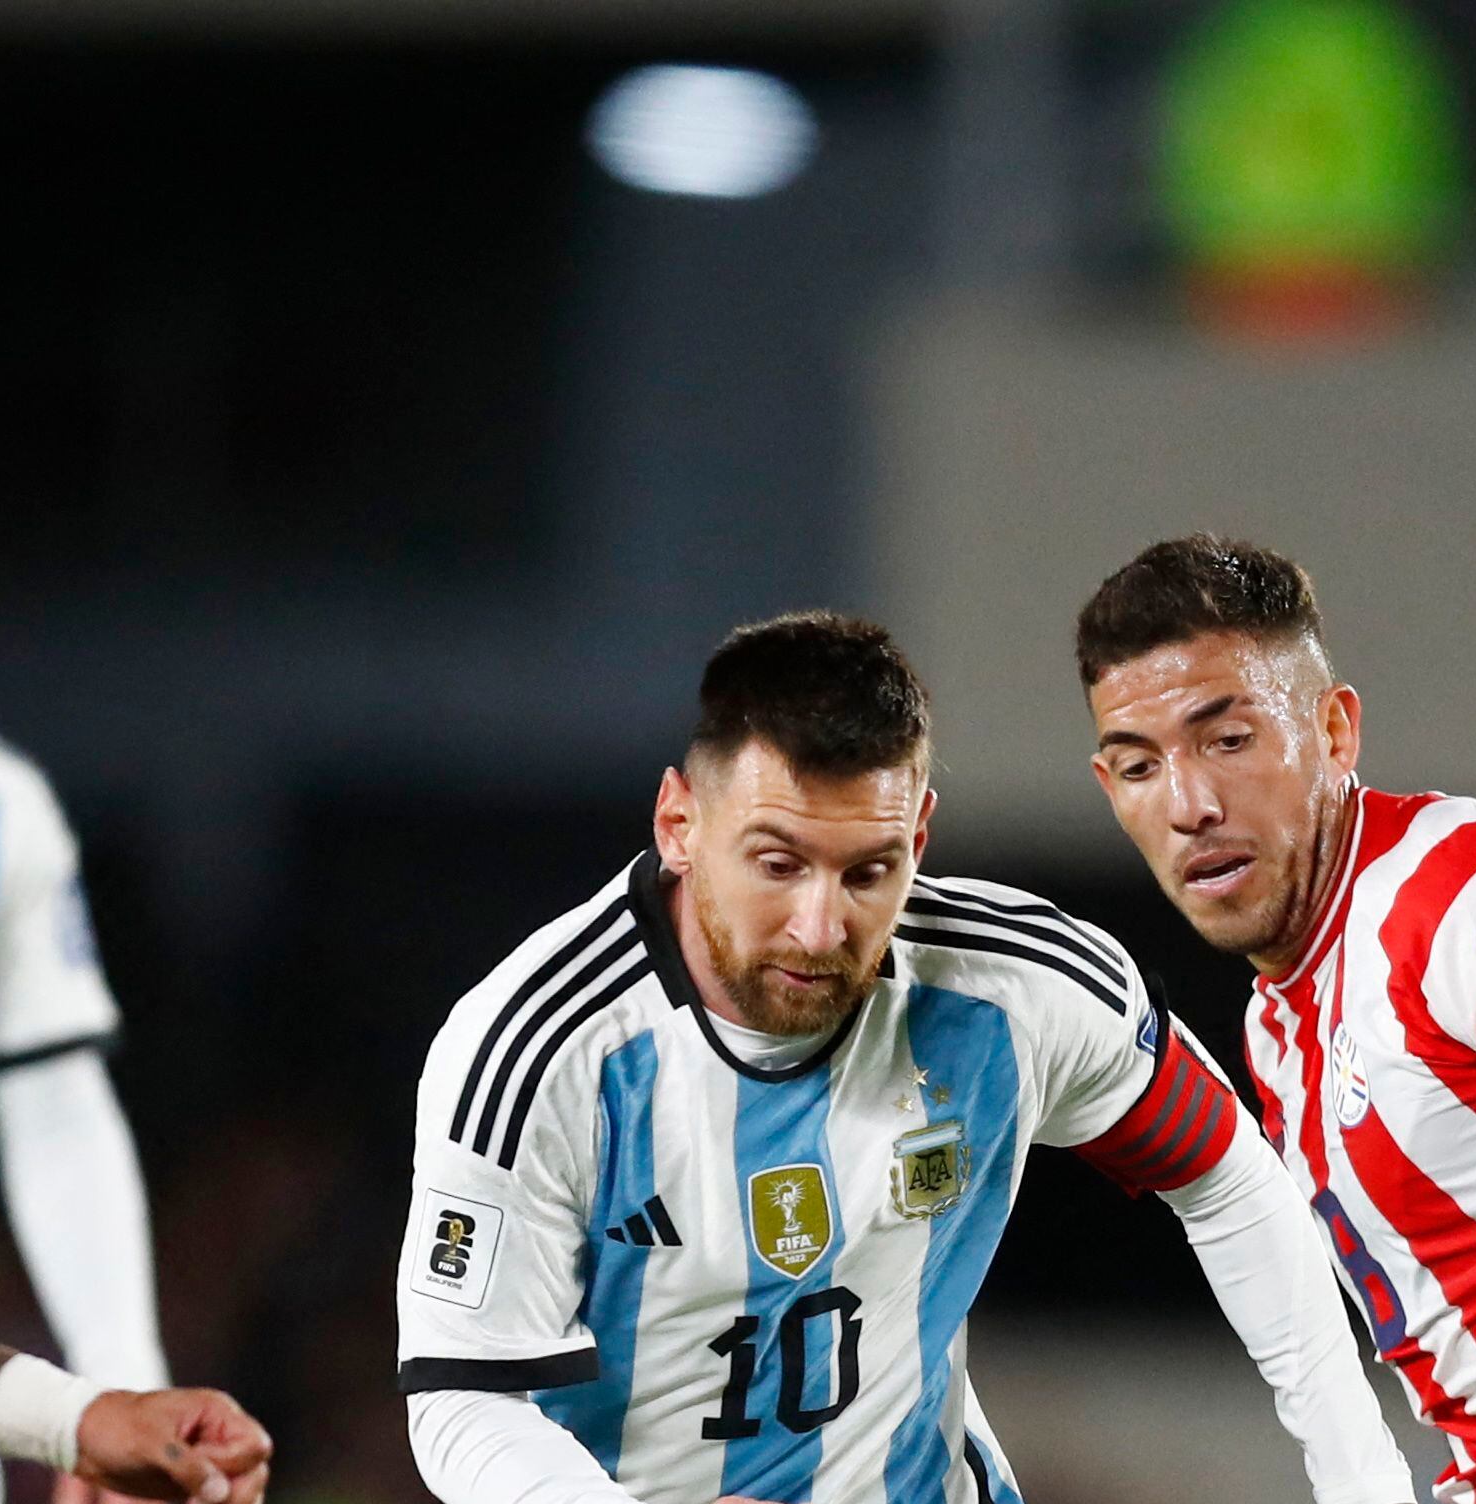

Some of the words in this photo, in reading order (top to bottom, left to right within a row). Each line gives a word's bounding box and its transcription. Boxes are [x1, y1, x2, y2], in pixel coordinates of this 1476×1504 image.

[908, 1149, 953, 1191] AFA
[776, 1234, 812, 1252] FIFA
[438, 1261, 456, 1273] FIFA
[785, 1254, 806, 1264] 2022
[1310, 1186, 1407, 1352] 8
[701, 1285, 863, 1440] 10
